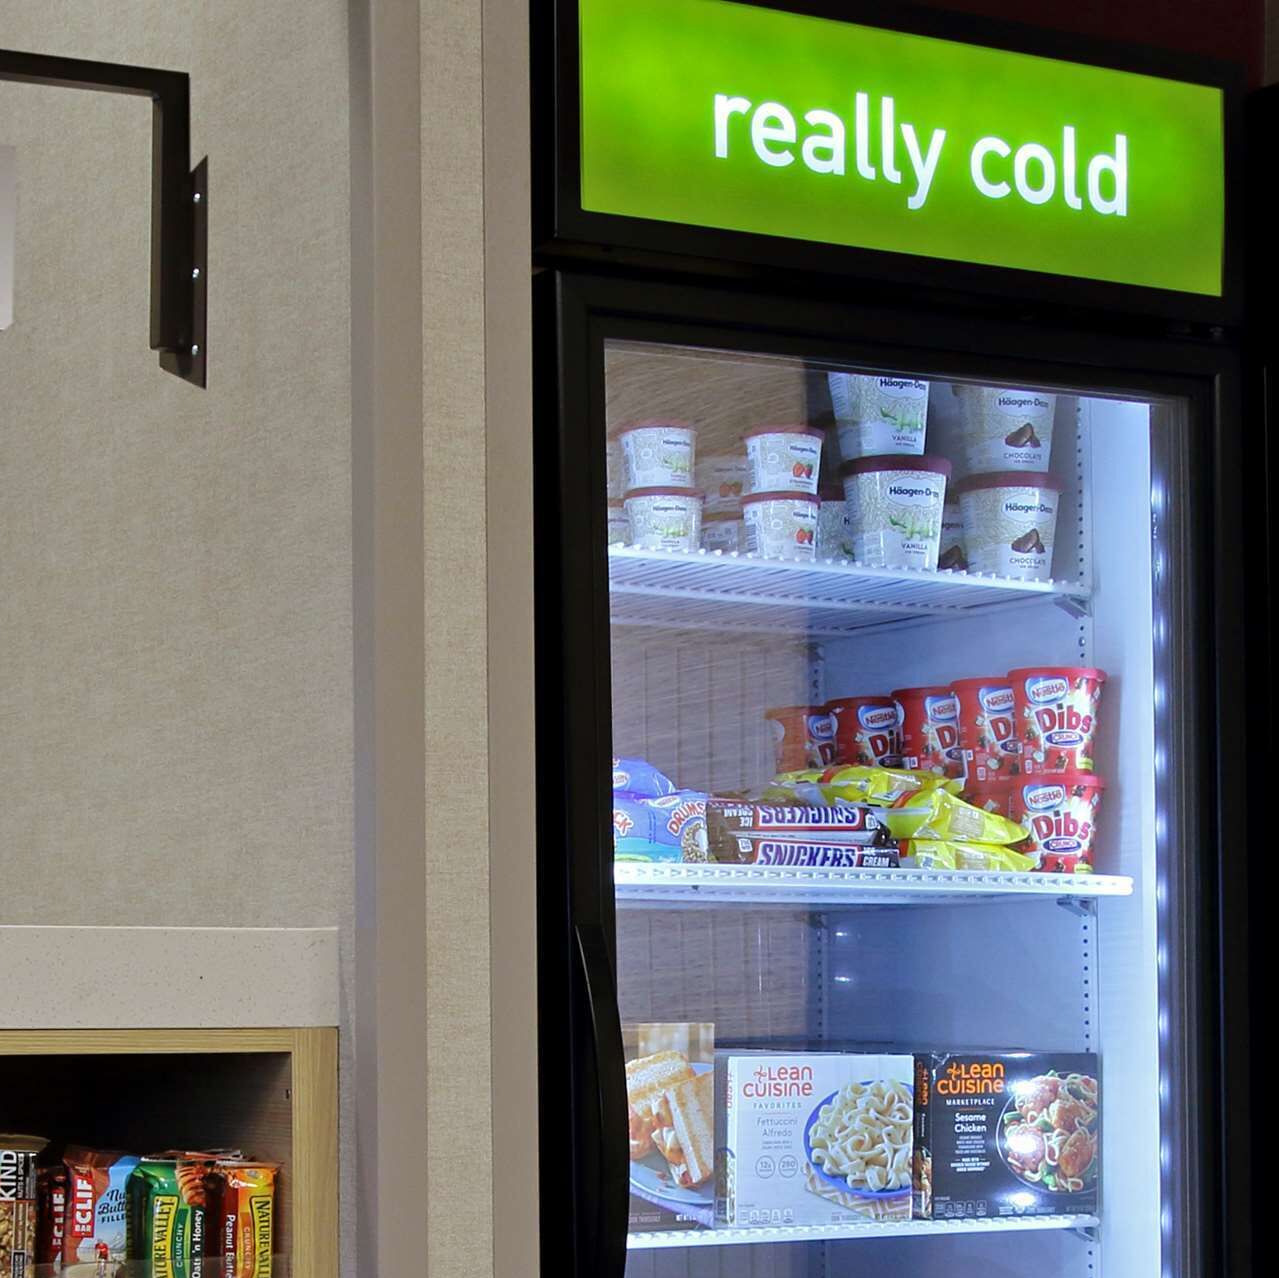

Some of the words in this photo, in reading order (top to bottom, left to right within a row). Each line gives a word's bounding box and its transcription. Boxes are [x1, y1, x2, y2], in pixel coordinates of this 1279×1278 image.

[713, 91, 946, 210] really
[971, 125, 1128, 216] cold
[1035, 703, 1092, 734] Dibs
[1032, 810, 1091, 841] Dibs
[756, 842, 857, 867] SNICKERS
[945, 1098, 995, 1106] MARKETPLACE
[954, 1112, 987, 1122] Sesame
[762, 1128, 793, 1138] Alfredo
[954, 1123, 987, 1133] Chicken
[0, 1151, 16, 1201] KIND
[75, 1178, 93, 1224] CLIF
[153, 1199, 175, 1243] VALLEY
[193, 1209, 204, 1243] Honey
[226, 1214, 236, 1255] Peanut
[256, 1200, 273, 1242] NATURE
